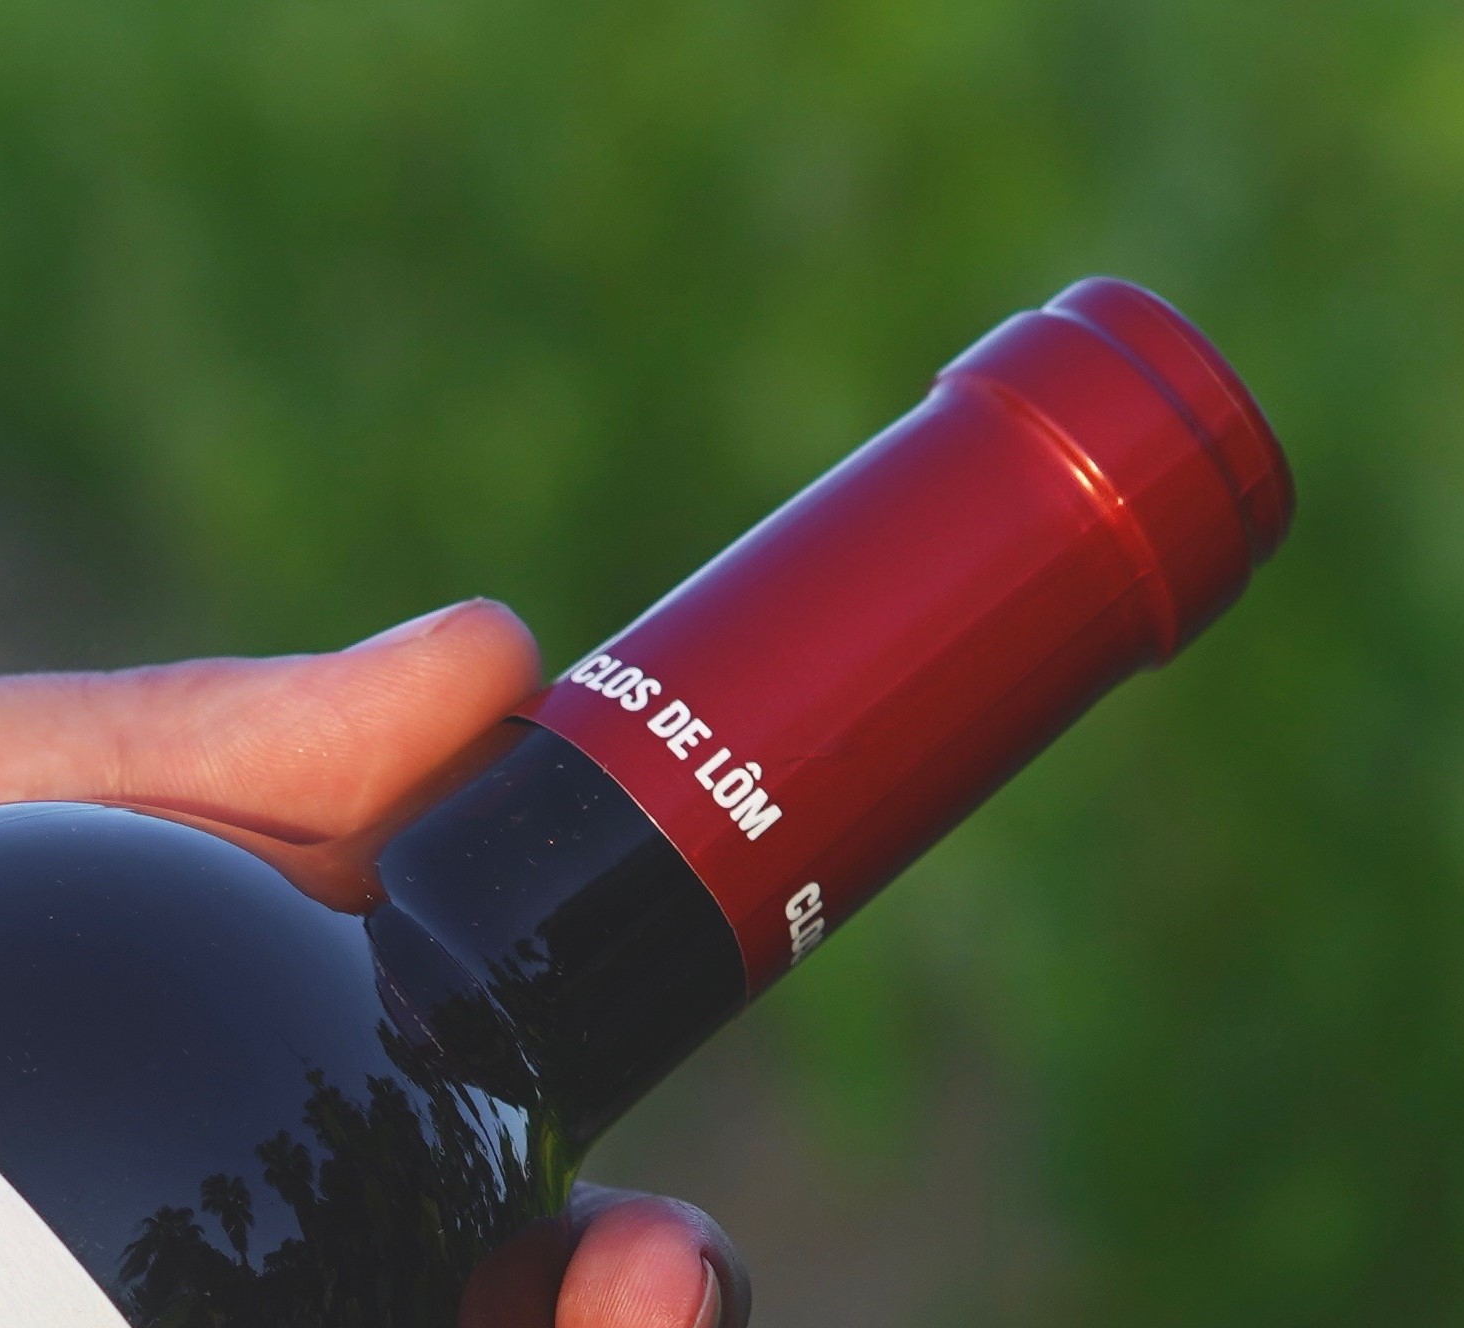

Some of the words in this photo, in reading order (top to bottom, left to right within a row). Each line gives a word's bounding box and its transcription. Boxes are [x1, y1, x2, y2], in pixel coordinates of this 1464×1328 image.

[570, 653, 662, 712] CLOS
[646, 699, 713, 760] DE
[693, 747, 783, 842] LÔM
